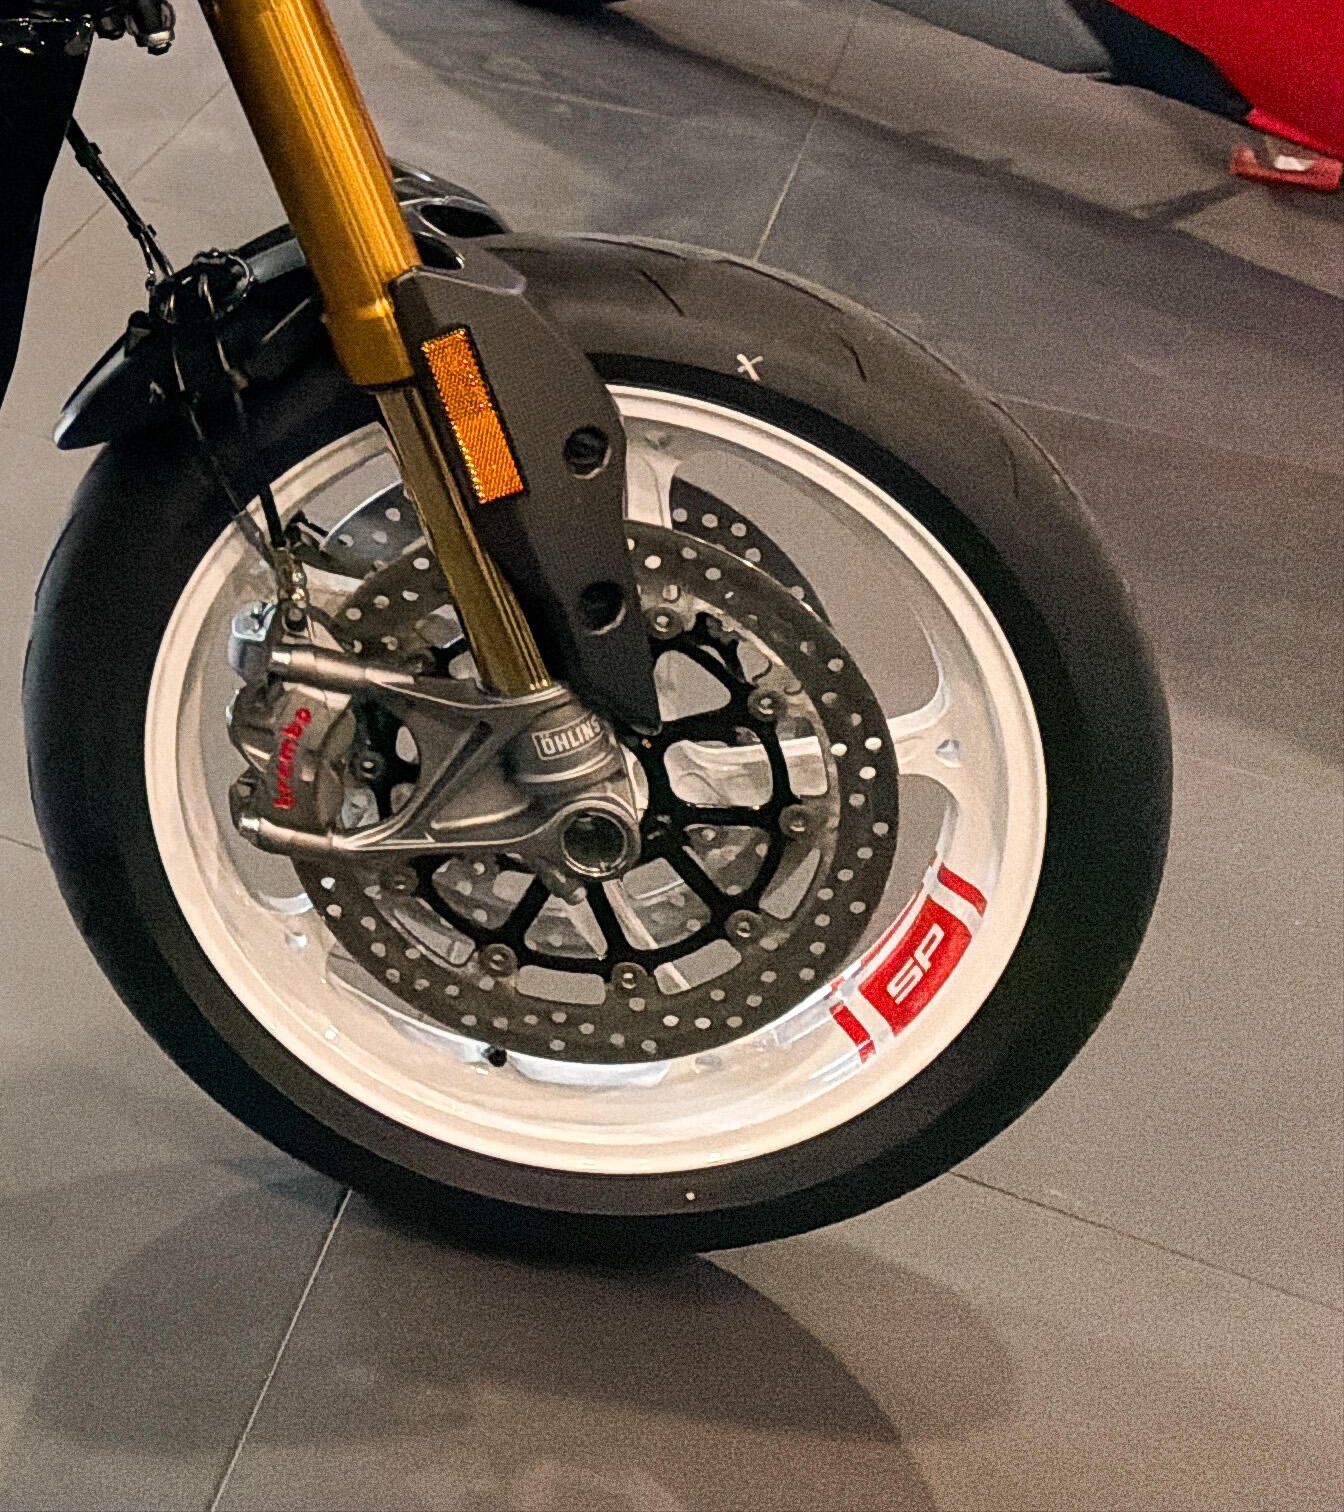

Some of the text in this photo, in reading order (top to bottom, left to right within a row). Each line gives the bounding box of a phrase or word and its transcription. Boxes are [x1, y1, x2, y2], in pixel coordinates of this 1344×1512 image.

[273, 707, 312, 809] brembo
[541, 713, 602, 756] ÖHLINS
[886, 922, 945, 1005] SP
